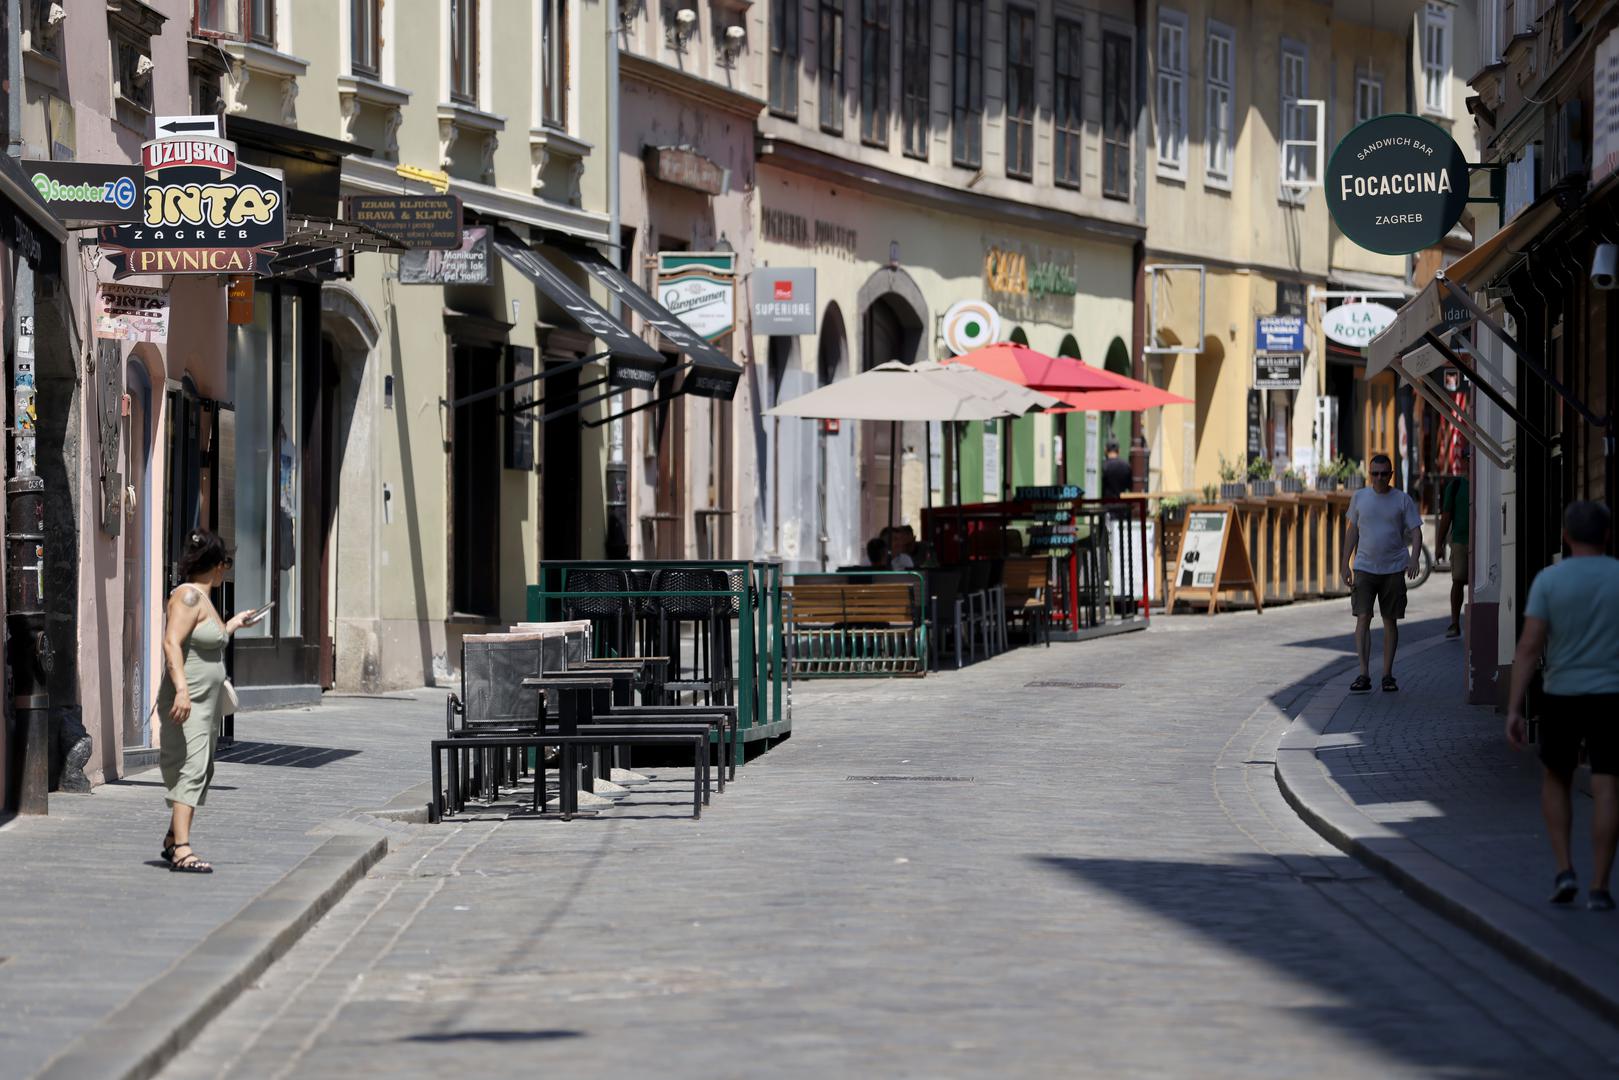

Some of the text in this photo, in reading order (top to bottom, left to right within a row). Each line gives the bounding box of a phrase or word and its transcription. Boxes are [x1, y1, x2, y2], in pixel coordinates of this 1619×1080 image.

[1356, 137, 1434, 161] SANDWICH BAR
[144, 184, 280, 227] INTA
[361, 201, 396, 209] IZRADA
[357, 211, 395, 220] BRAVA
[401, 211, 411, 220] &
[1375, 213, 1423, 225] ZAGREB
[134, 230, 248, 239] ZAGREB
[141, 250, 244, 270] PIVNICA
[444, 252, 483, 260] Manikura
[470, 261, 483, 270] lak
[108, 286, 160, 296] PIVNICA
[754, 302, 812, 316] SUPERIORE
[1352, 312, 1371, 323] LA
[1334, 323, 1385, 337] ROCK
